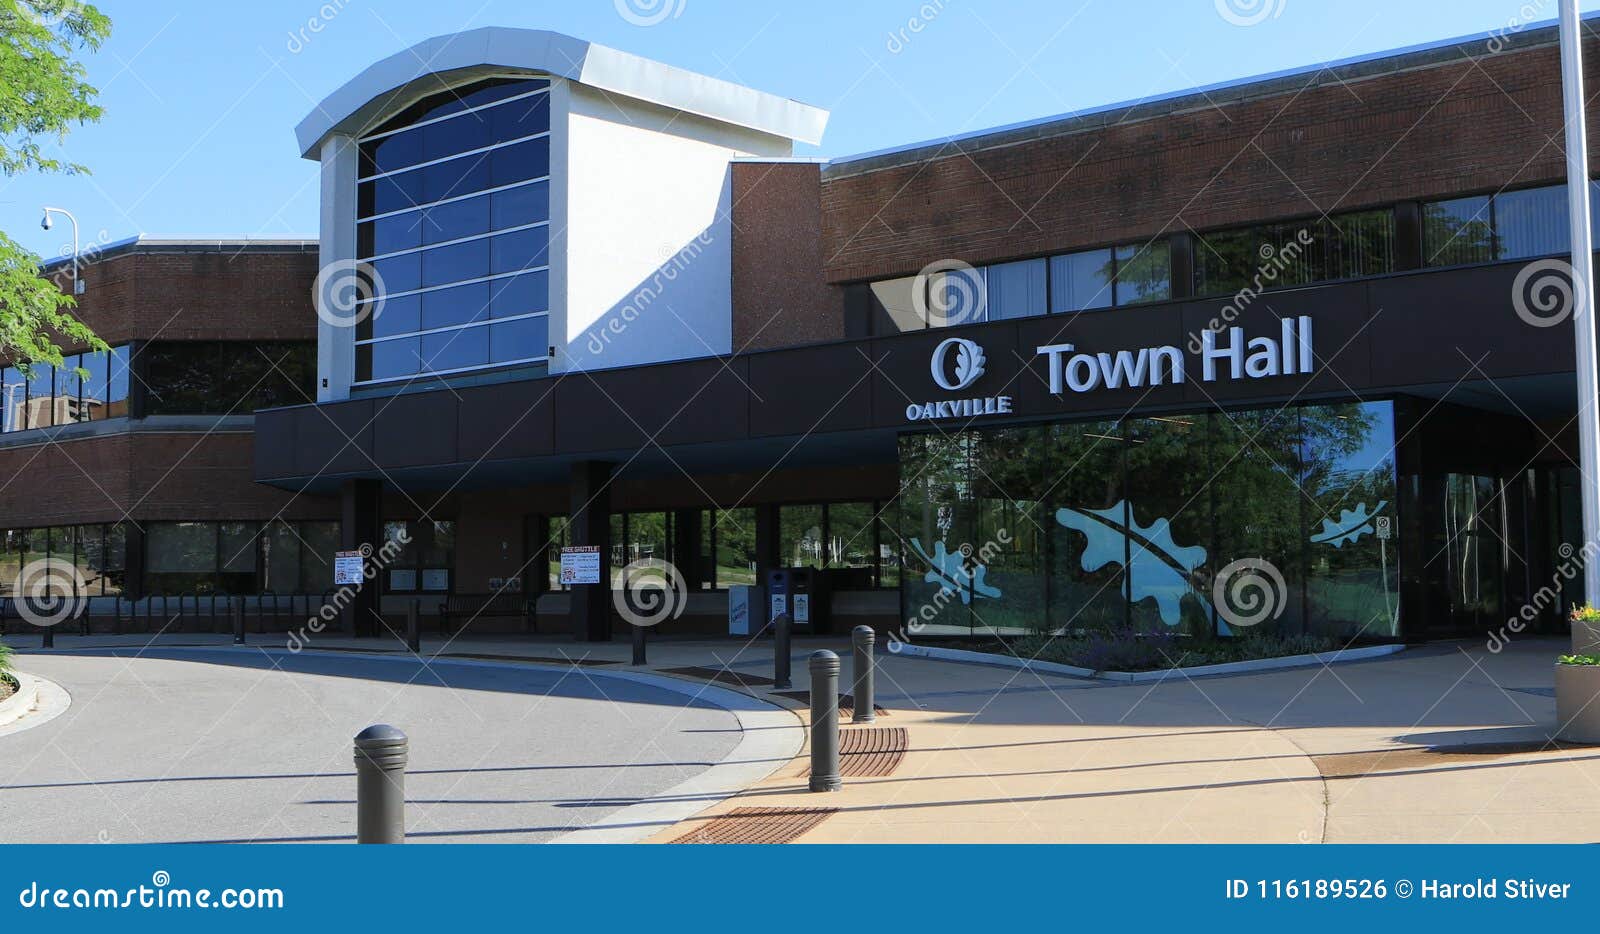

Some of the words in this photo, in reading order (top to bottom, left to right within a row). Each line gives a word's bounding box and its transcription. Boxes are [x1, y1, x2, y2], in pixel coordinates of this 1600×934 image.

[1036, 343, 1185, 394] Town
[1201, 315, 1313, 381] Hall
[905, 396, 1012, 420] OAKVILLE
